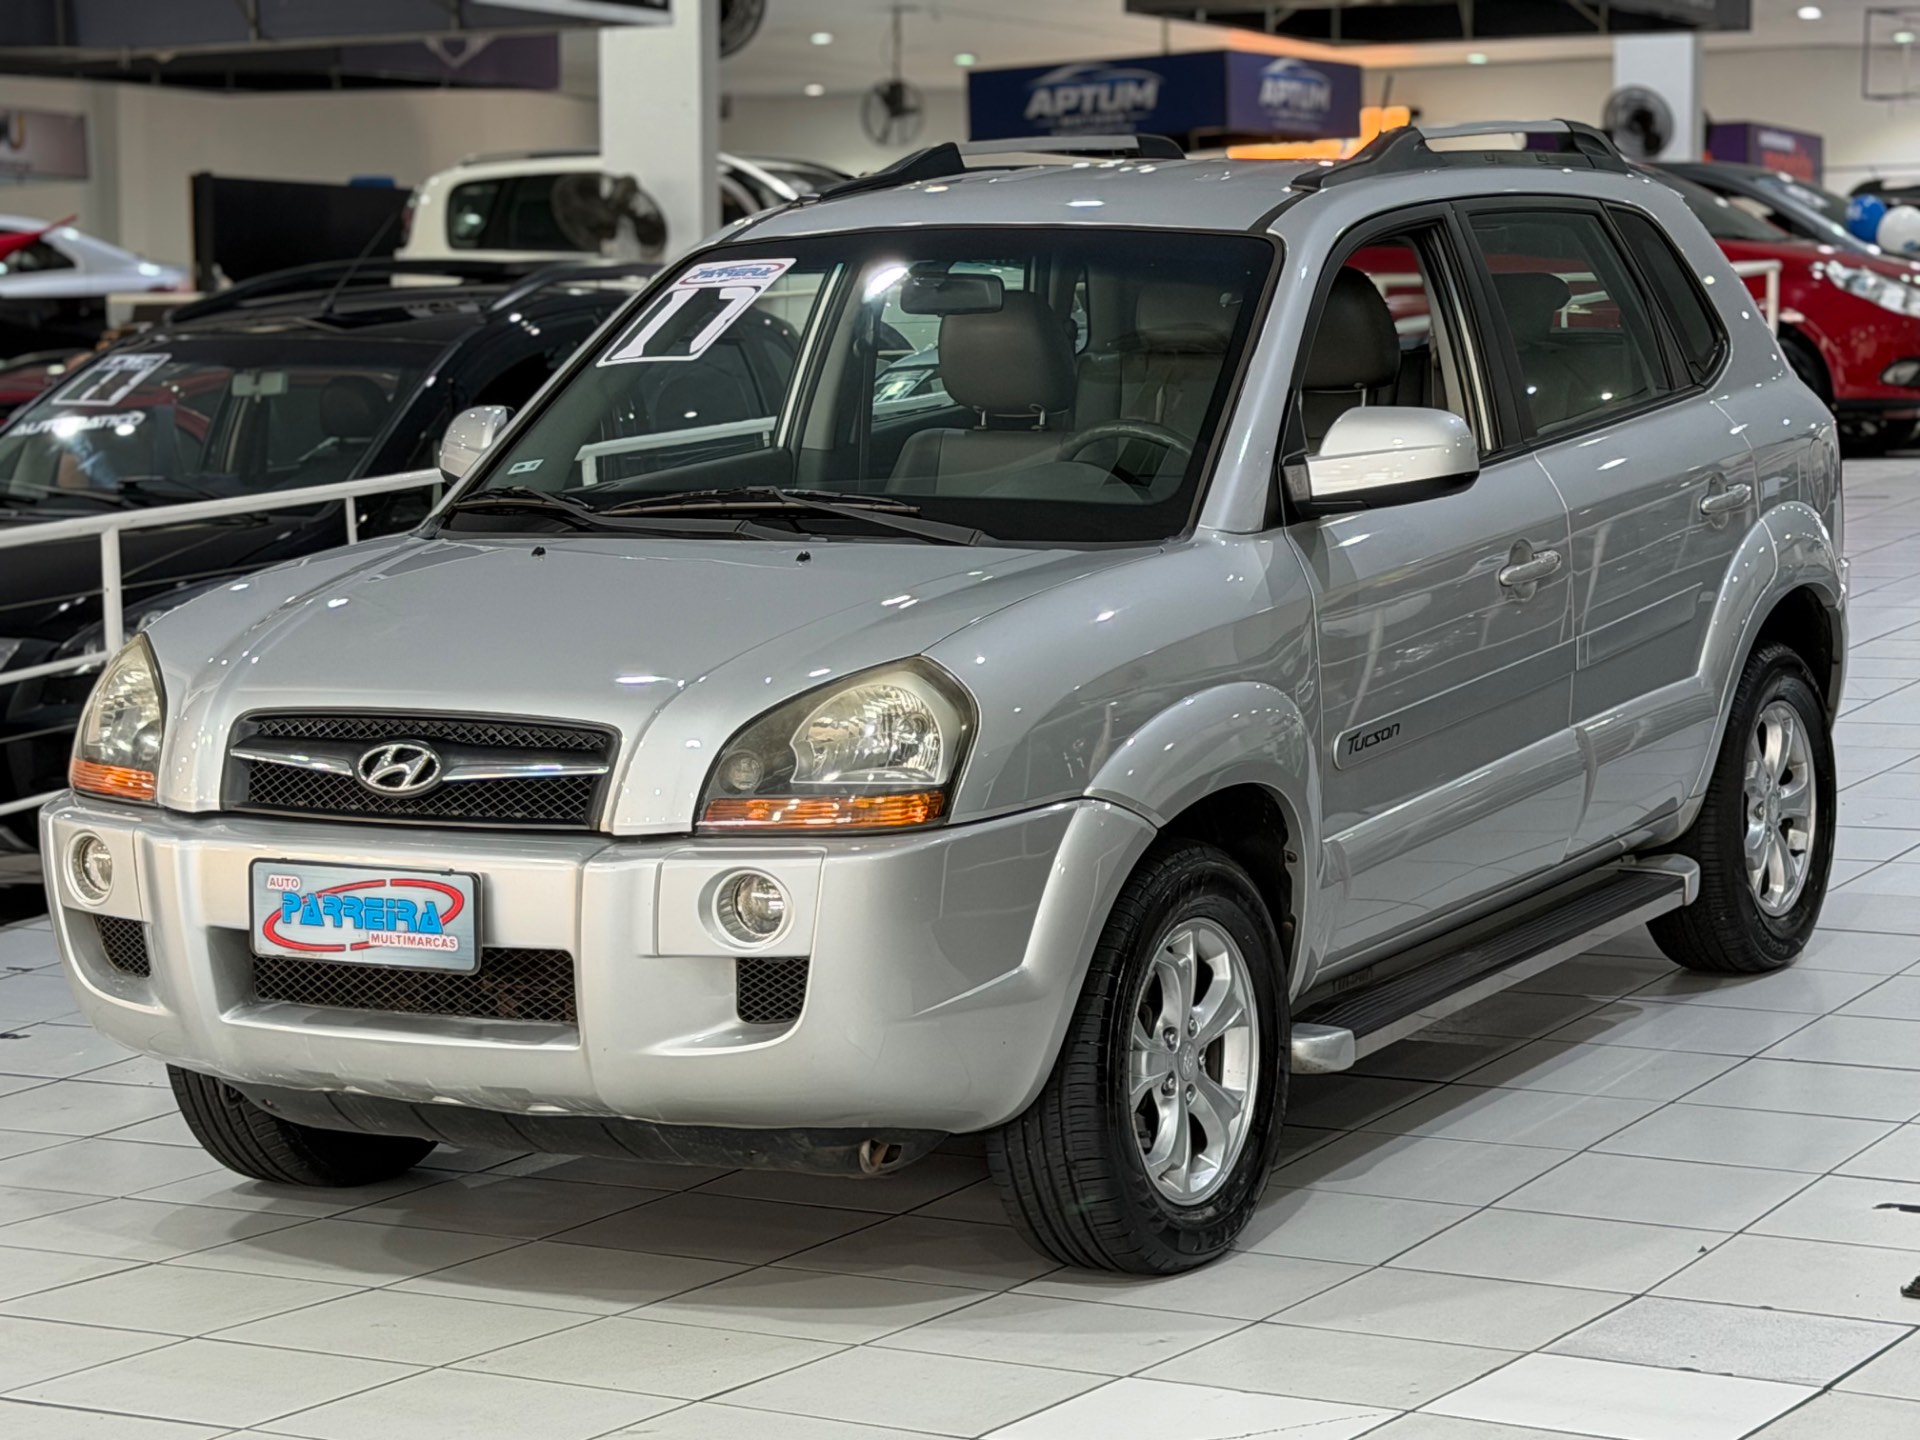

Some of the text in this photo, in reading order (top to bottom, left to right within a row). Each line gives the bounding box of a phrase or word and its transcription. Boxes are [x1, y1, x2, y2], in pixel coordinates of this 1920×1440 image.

[1024, 79, 1160, 118] APTUM
[1258, 78, 1331, 112] APTUM
[9, 410, 146, 436] AUTATICO
[1347, 722, 1400, 755] Tucson
[269, 875, 299, 888] AUTO
[282, 892, 443, 933] PARREIRA
[370, 933, 457, 949] MULTIMARCAS
